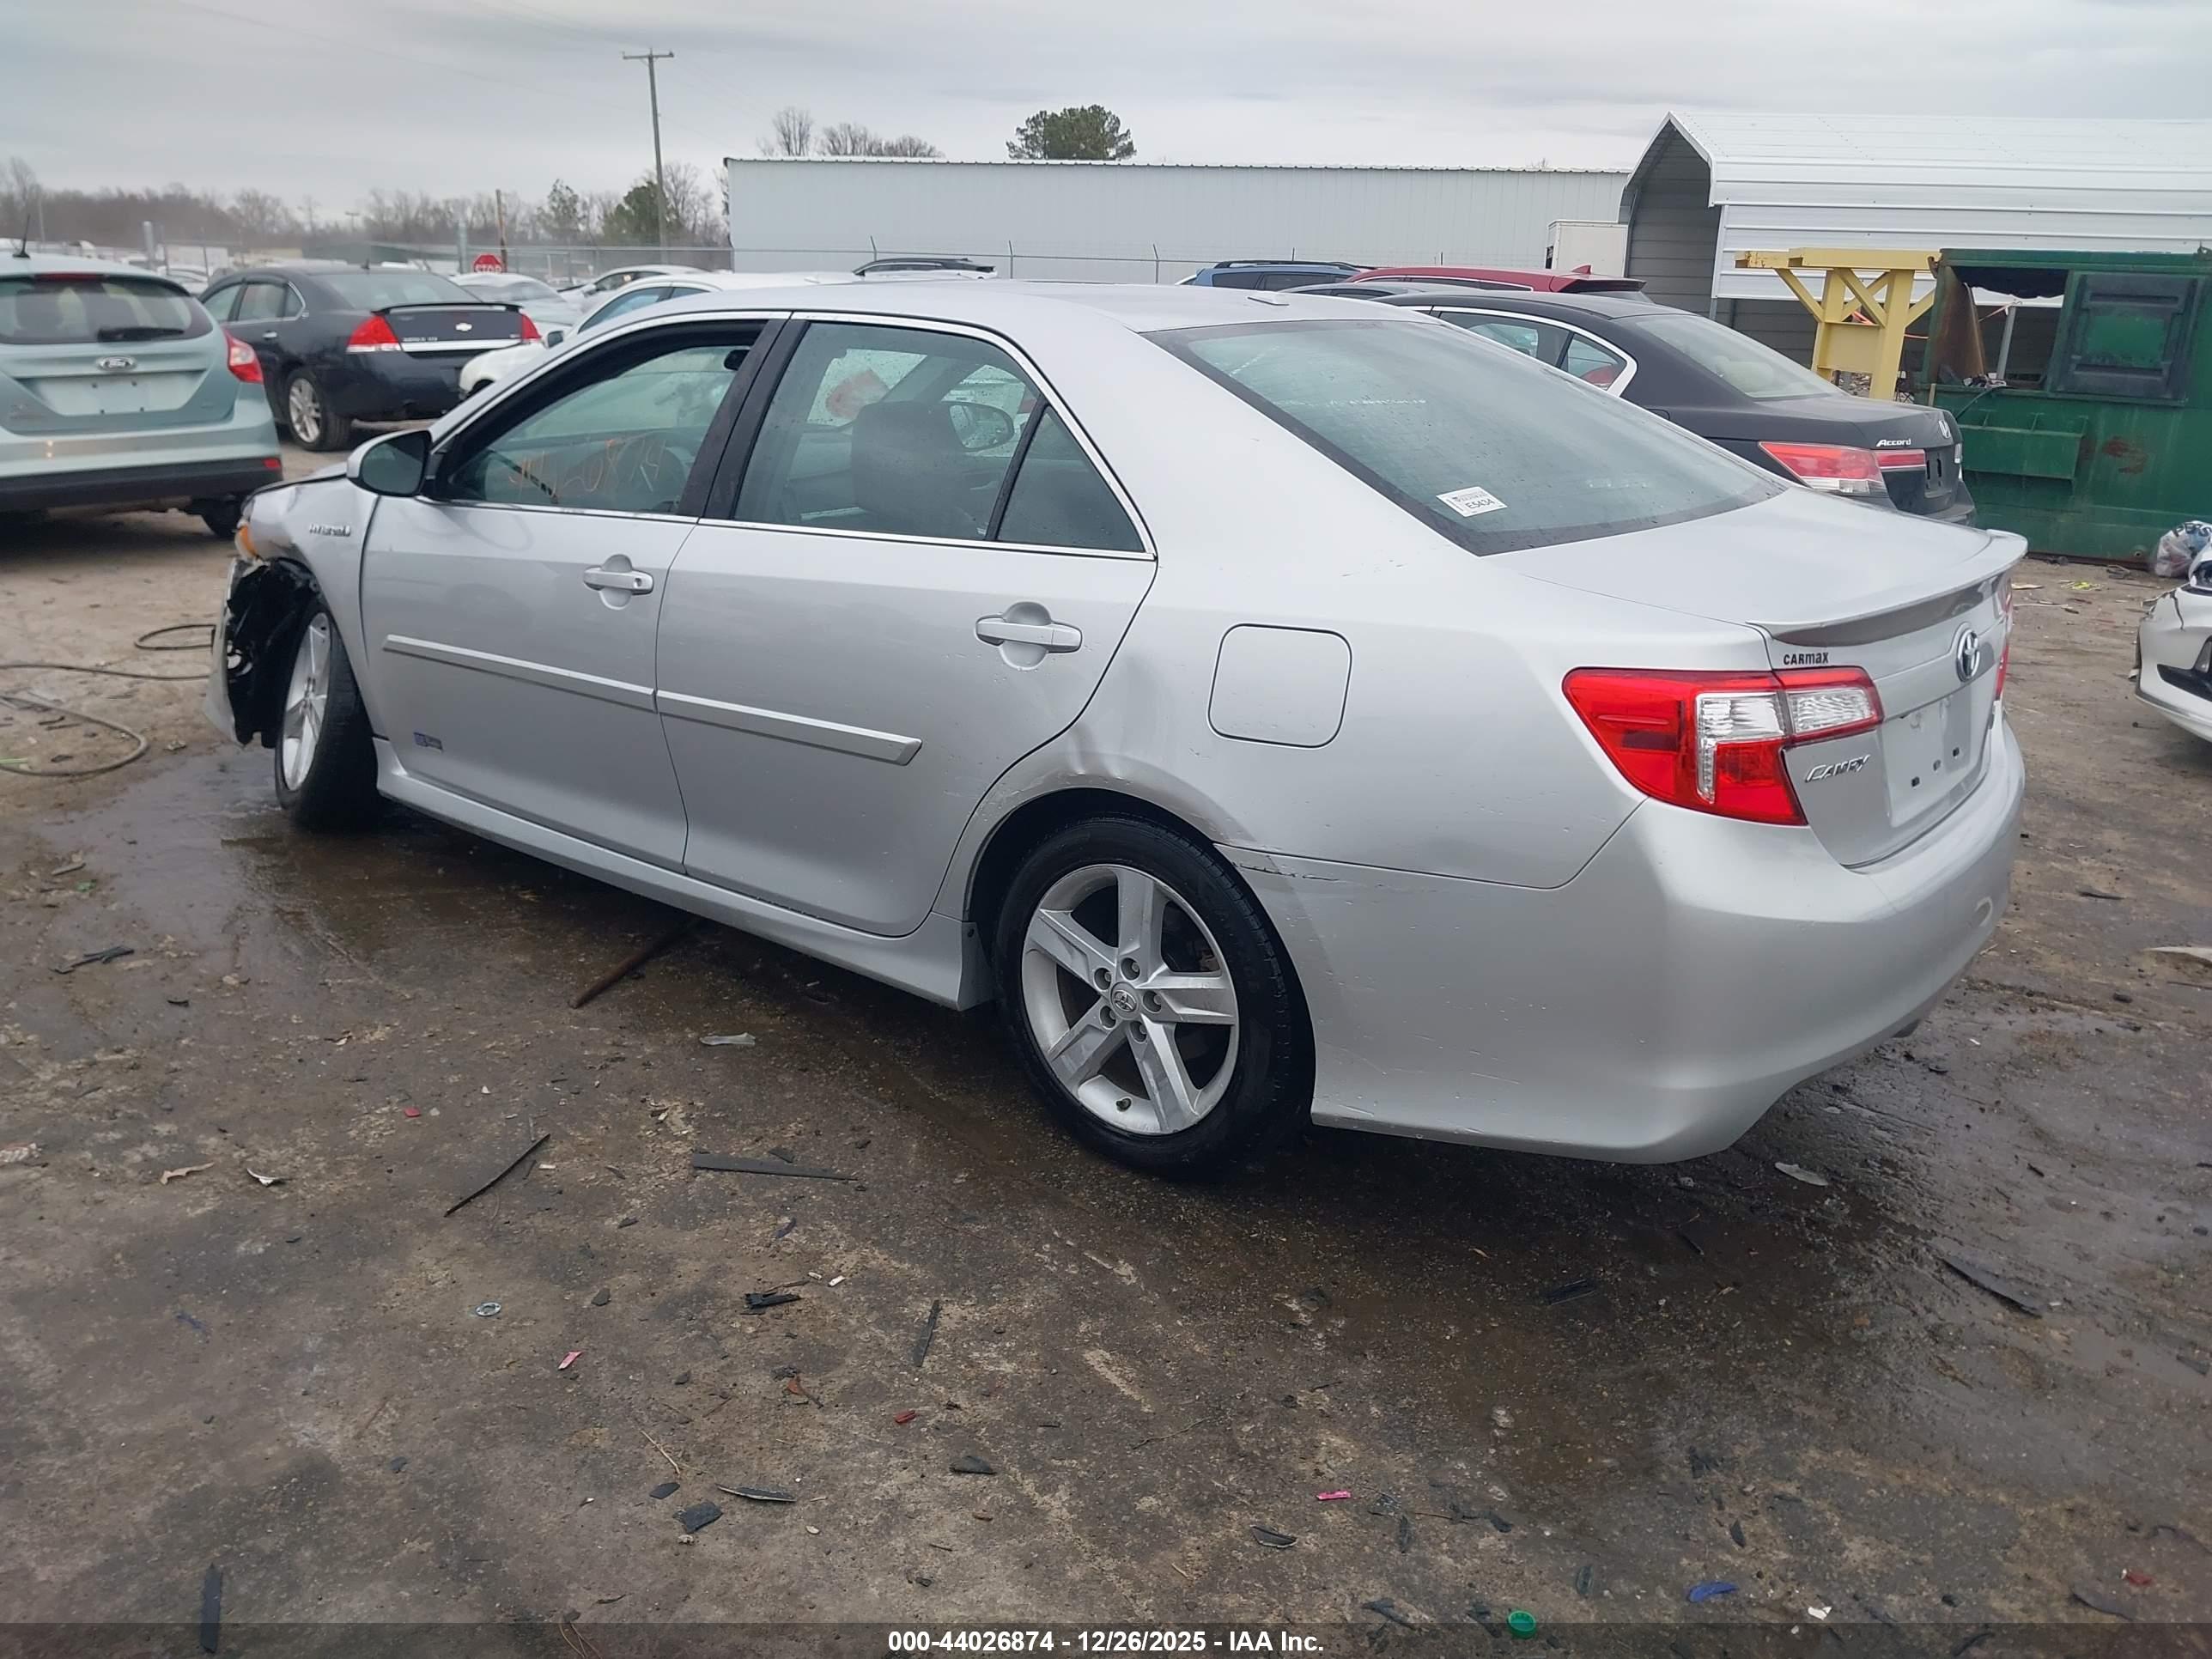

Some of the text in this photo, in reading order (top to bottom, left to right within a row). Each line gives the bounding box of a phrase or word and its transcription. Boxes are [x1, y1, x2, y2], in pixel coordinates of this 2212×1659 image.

[474, 264, 502, 274] STOP
[1875, 438, 1911, 447] Accord
[1804, 754, 1871, 782] CAMRY
